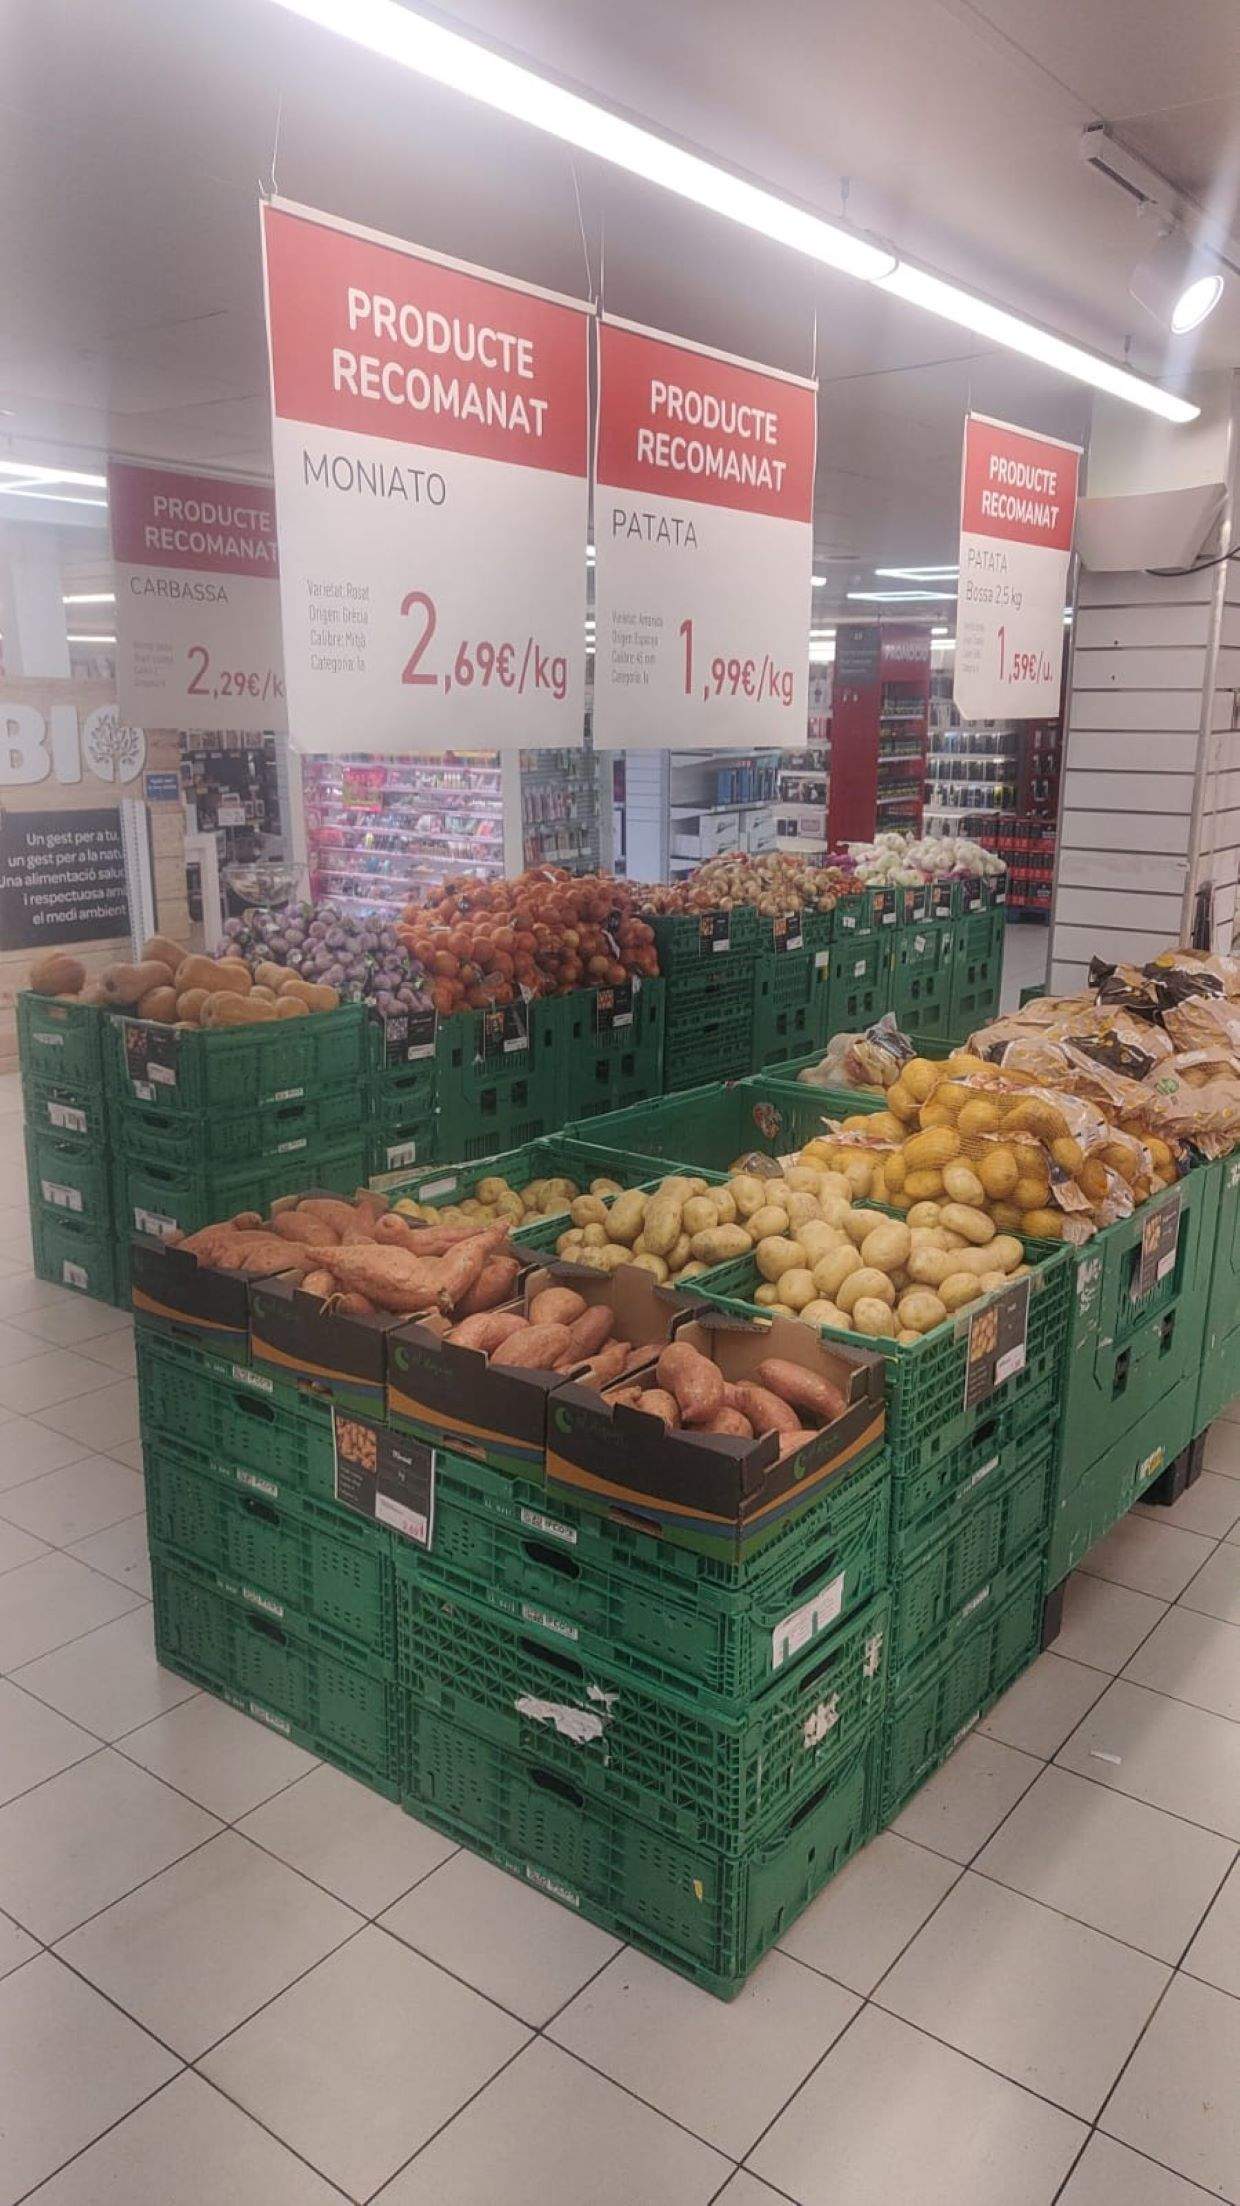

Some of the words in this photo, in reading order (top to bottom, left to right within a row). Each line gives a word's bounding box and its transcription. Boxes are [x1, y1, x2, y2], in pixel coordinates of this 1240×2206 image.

[347, 286, 535, 380] PRODUCTE
[332, 347, 549, 438] RECOMANAT
[651, 379, 779, 446] PRODUCTE
[303, 450, 447, 506] MONIATO
[637, 428, 788, 493] RECOMANAT
[988, 454, 1057, 496] PRODUCTE
[153, 495, 272, 532] PRODUCTE
[613, 509, 698, 548] PATATA
[981, 490, 1060, 530] RECOMANAT
[144, 526, 279, 563] RECOMANAT
[967, 548, 1008, 573] PATATA
[130, 576, 228, 603] CARBASSA
[966, 580, 993, 603] Bossa
[1011, 584, 1023, 611] kg
[400, 591, 568, 700] 2,69€/kg
[680, 619, 794, 706] 1,99€/kg
[187, 646, 284, 701] 2,29€/k
[8, 856, 24, 868] un
[27, 853, 54, 870] gest
[56, 852, 77, 866] per
[79, 851, 86, 863] a
[87, 848, 98, 862] la
[26, 832, 45, 846] Un
[46, 832, 73, 848] gest
[75, 831, 95, 846] per
[97, 831, 104, 842] a
[25, 867, 97, 887] alimentació
[30, 888, 104, 905] respectuosa
[33, 910, 45, 925] el
[79, 903, 127, 920] ambient
